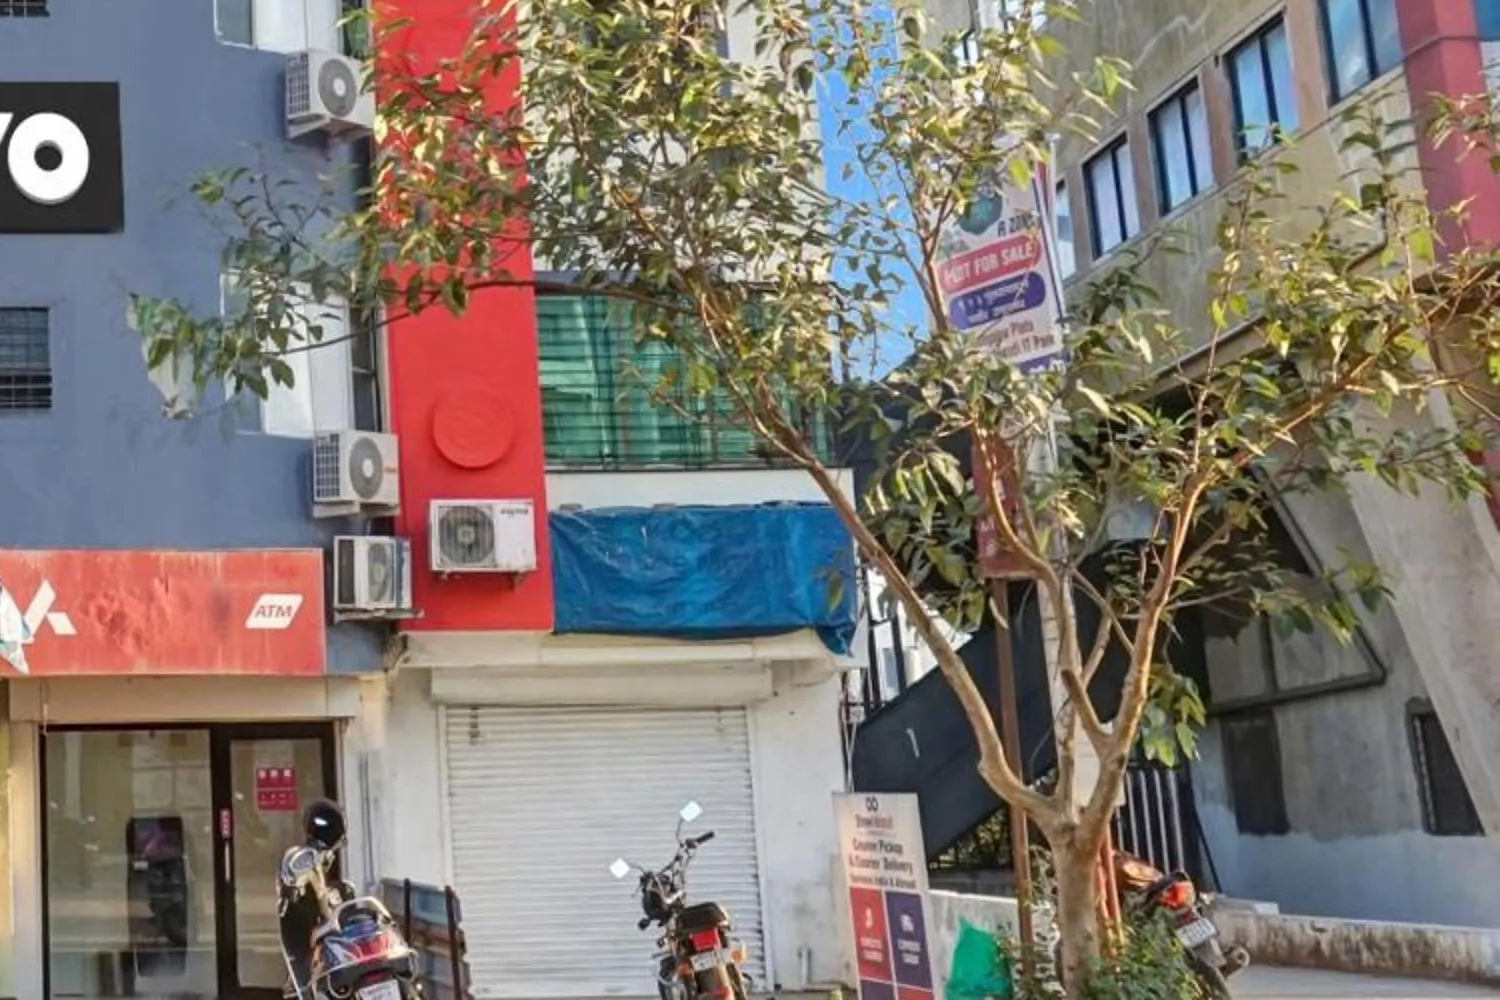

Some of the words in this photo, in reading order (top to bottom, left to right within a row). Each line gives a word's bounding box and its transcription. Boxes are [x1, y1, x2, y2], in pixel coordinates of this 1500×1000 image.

[974, 253, 999, 276] FOR
[1001, 241, 1036, 266] SALE
[255, 604, 293, 618] ATM
